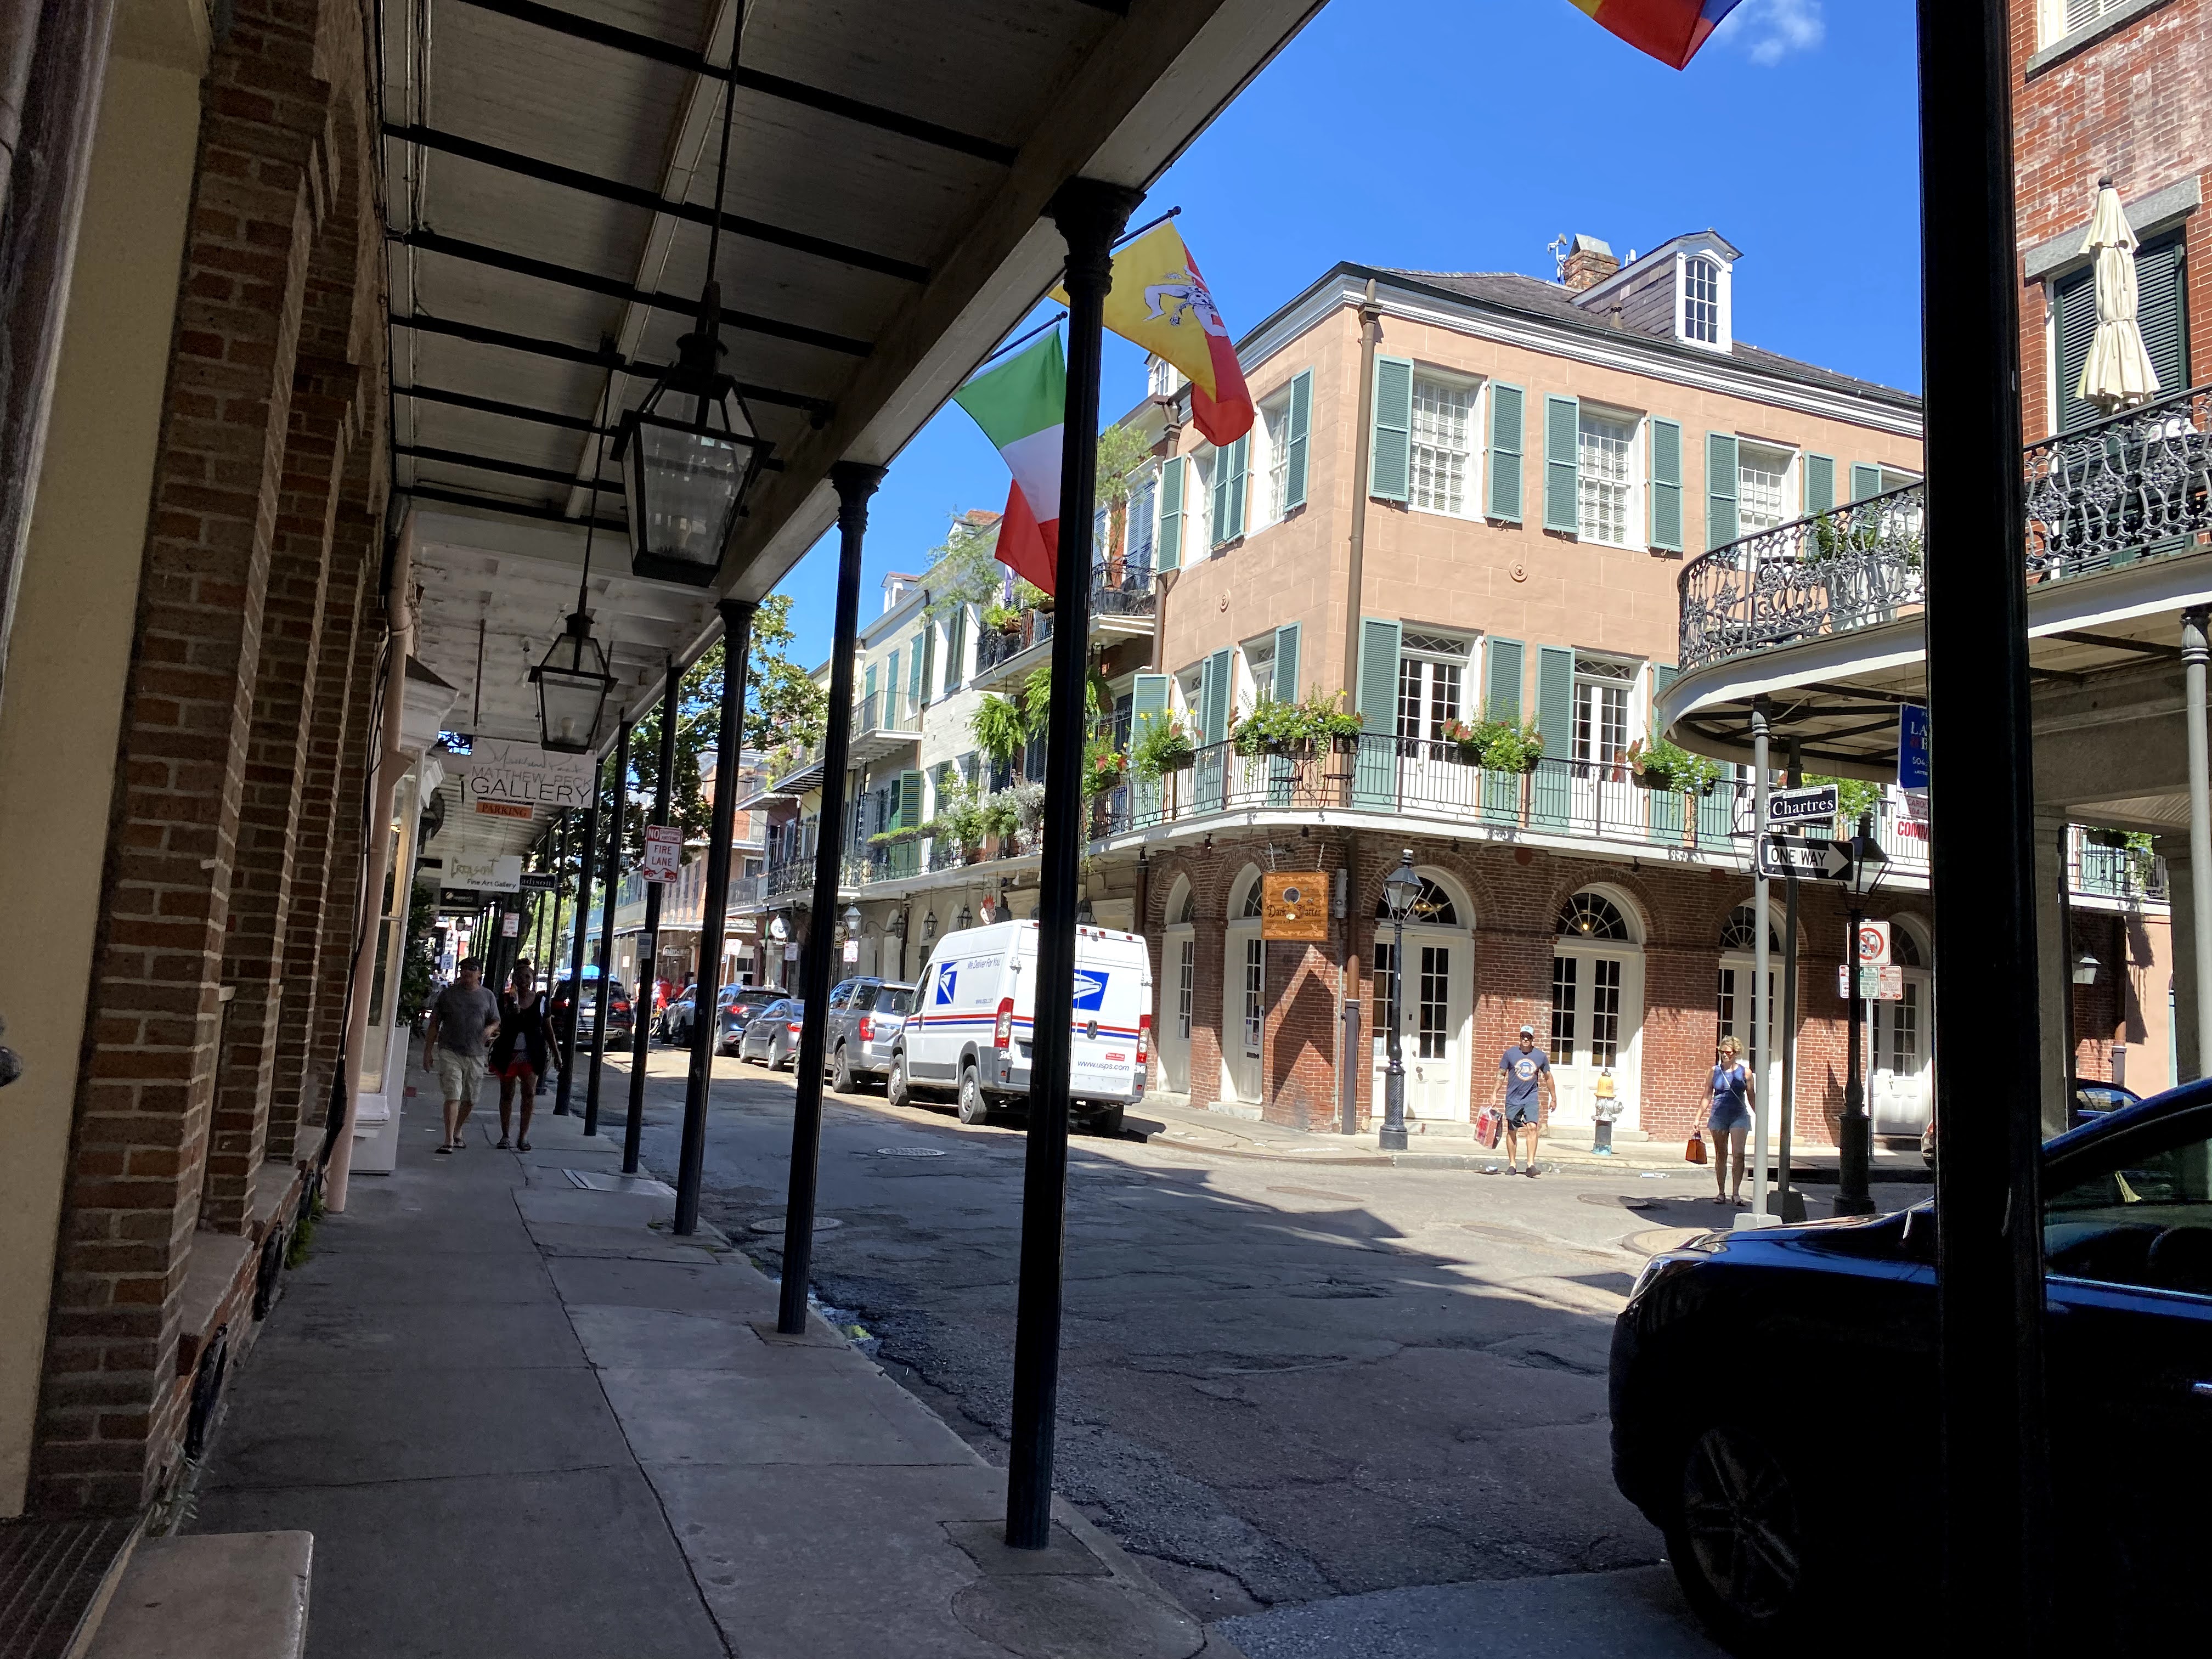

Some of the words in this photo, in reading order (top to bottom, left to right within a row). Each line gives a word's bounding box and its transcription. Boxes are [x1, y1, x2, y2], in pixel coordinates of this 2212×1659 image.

[472, 766, 546, 784] MATTHEW
[553, 775, 592, 789] PECK
[471, 776, 591, 804] GALLERY
[482, 804, 527, 817] PARKING
[1772, 799, 1833, 816] Chartres
[648, 828, 660, 840] NO
[654, 845, 672, 855] FIRE
[652, 856, 673, 867] LANE
[1771, 848, 1796, 864] ONE
[1801, 850, 1826, 867] WAY
[494, 881, 517, 889] Gallery
[1267, 905, 1288, 918] Dark
[1295, 905, 1322, 919] Matter
[967, 961, 974, 970] We
[973, 959, 986, 969] Deliver
[1077, 1060, 1130, 1071] www.usps.com
